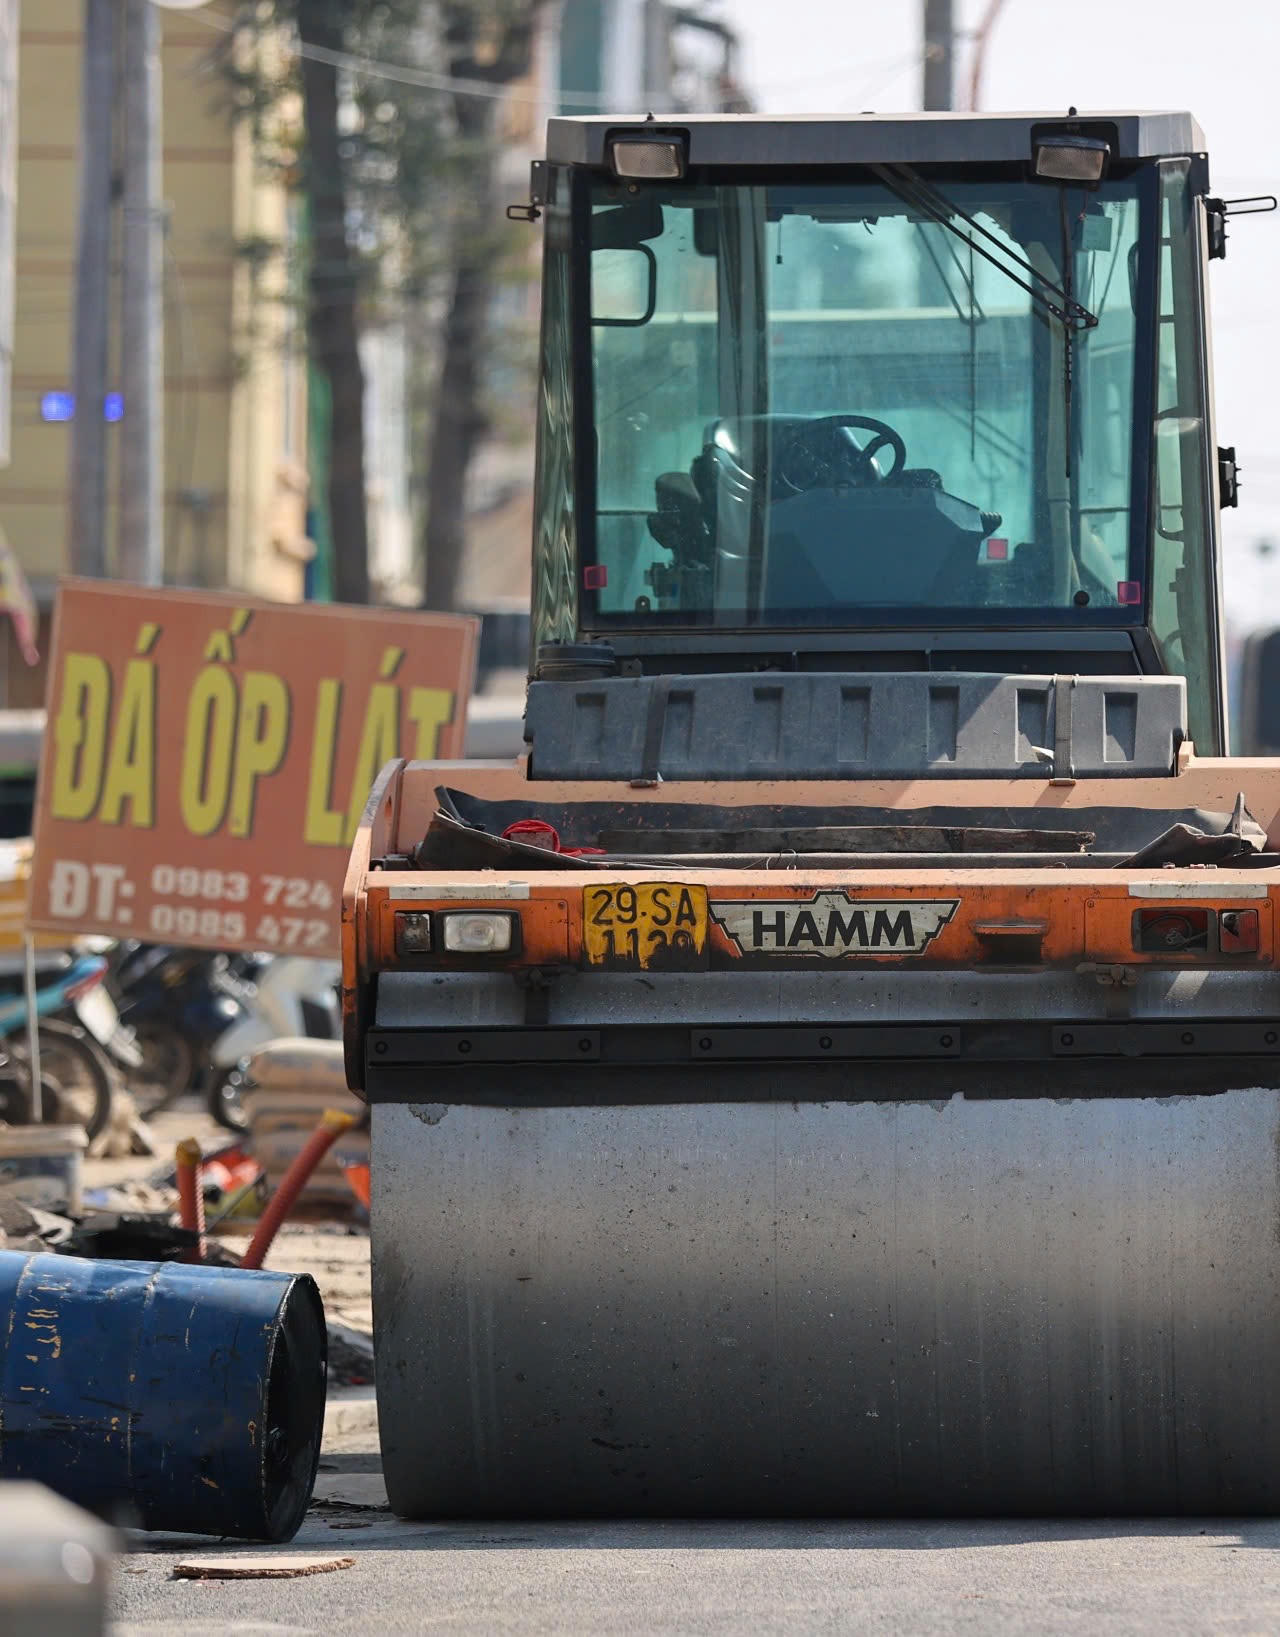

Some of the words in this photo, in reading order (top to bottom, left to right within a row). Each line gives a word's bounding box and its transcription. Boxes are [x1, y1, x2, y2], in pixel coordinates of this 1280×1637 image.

[52, 622, 161, 828] ĐÁ
[180, 609, 291, 838] ỐP
[51, 860, 136, 924] ĐT:
[752, 910, 916, 947] HAMM
